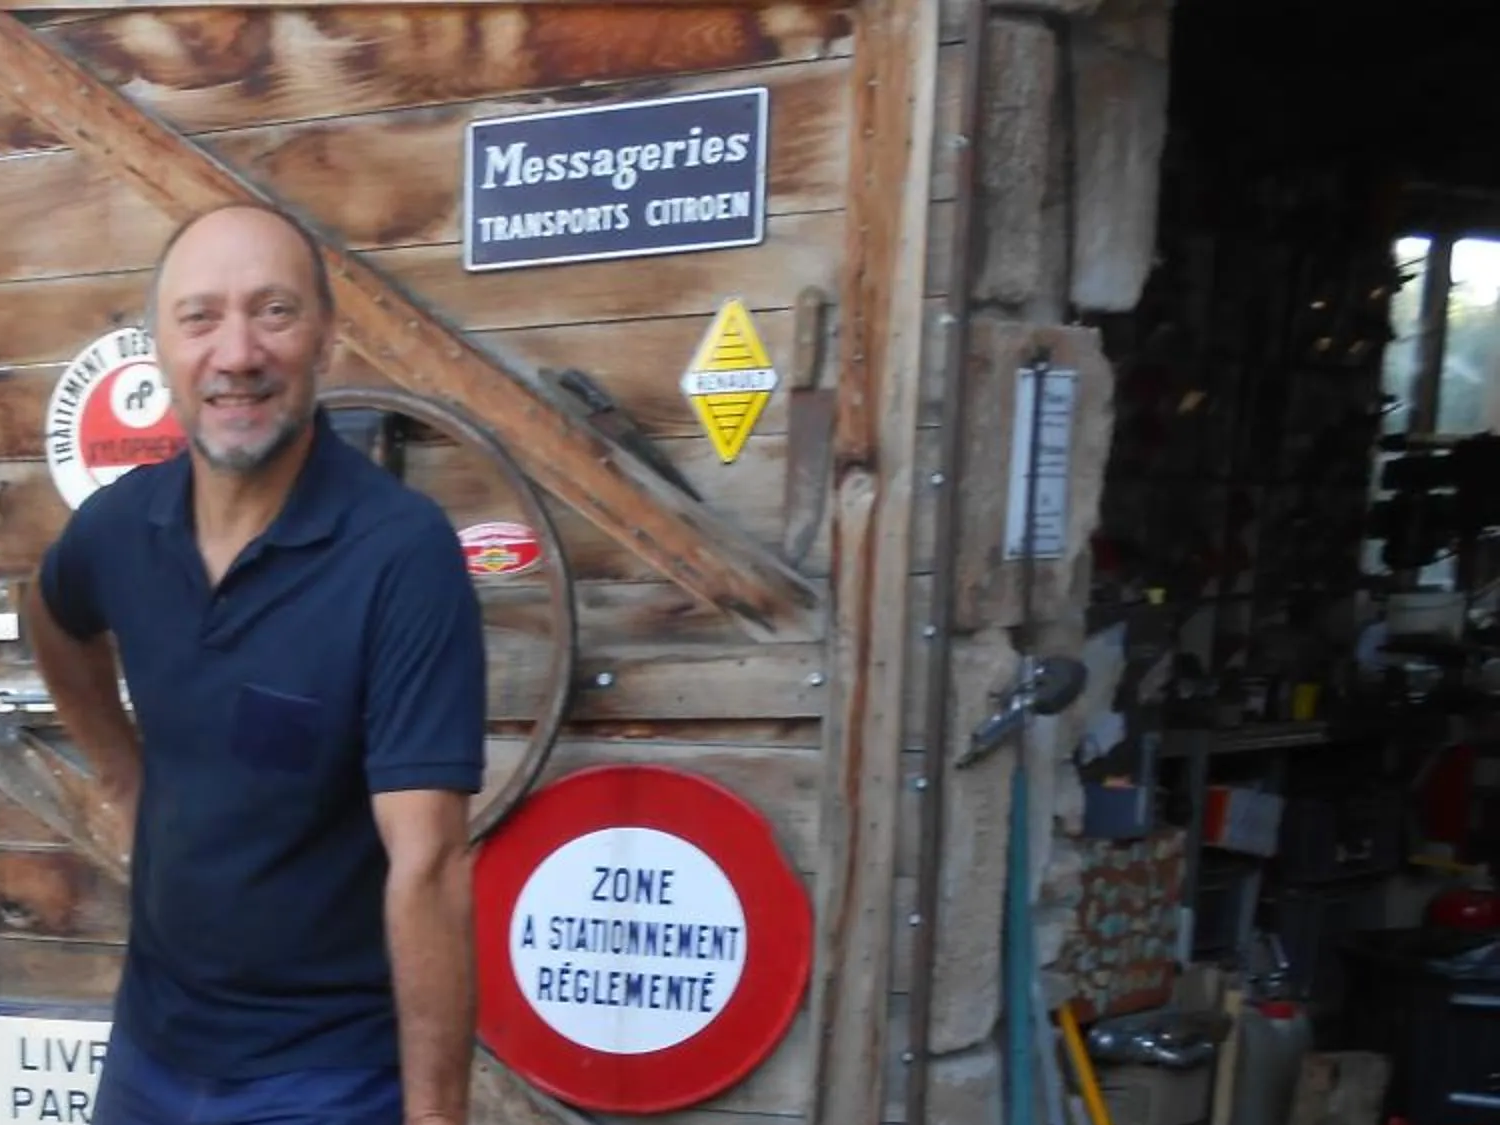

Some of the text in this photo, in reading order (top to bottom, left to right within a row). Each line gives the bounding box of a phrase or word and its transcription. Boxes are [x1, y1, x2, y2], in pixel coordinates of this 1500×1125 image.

[479, 126, 751, 191] Messageries
[478, 203, 630, 243] TRANSPORTS
[592, 866, 675, 905] ZONE
[521, 914, 741, 961] A STATIONNEMENT
[537, 961, 717, 1013] RÉGLEMENTÉ
[11, 1086, 91, 1125] PAR
